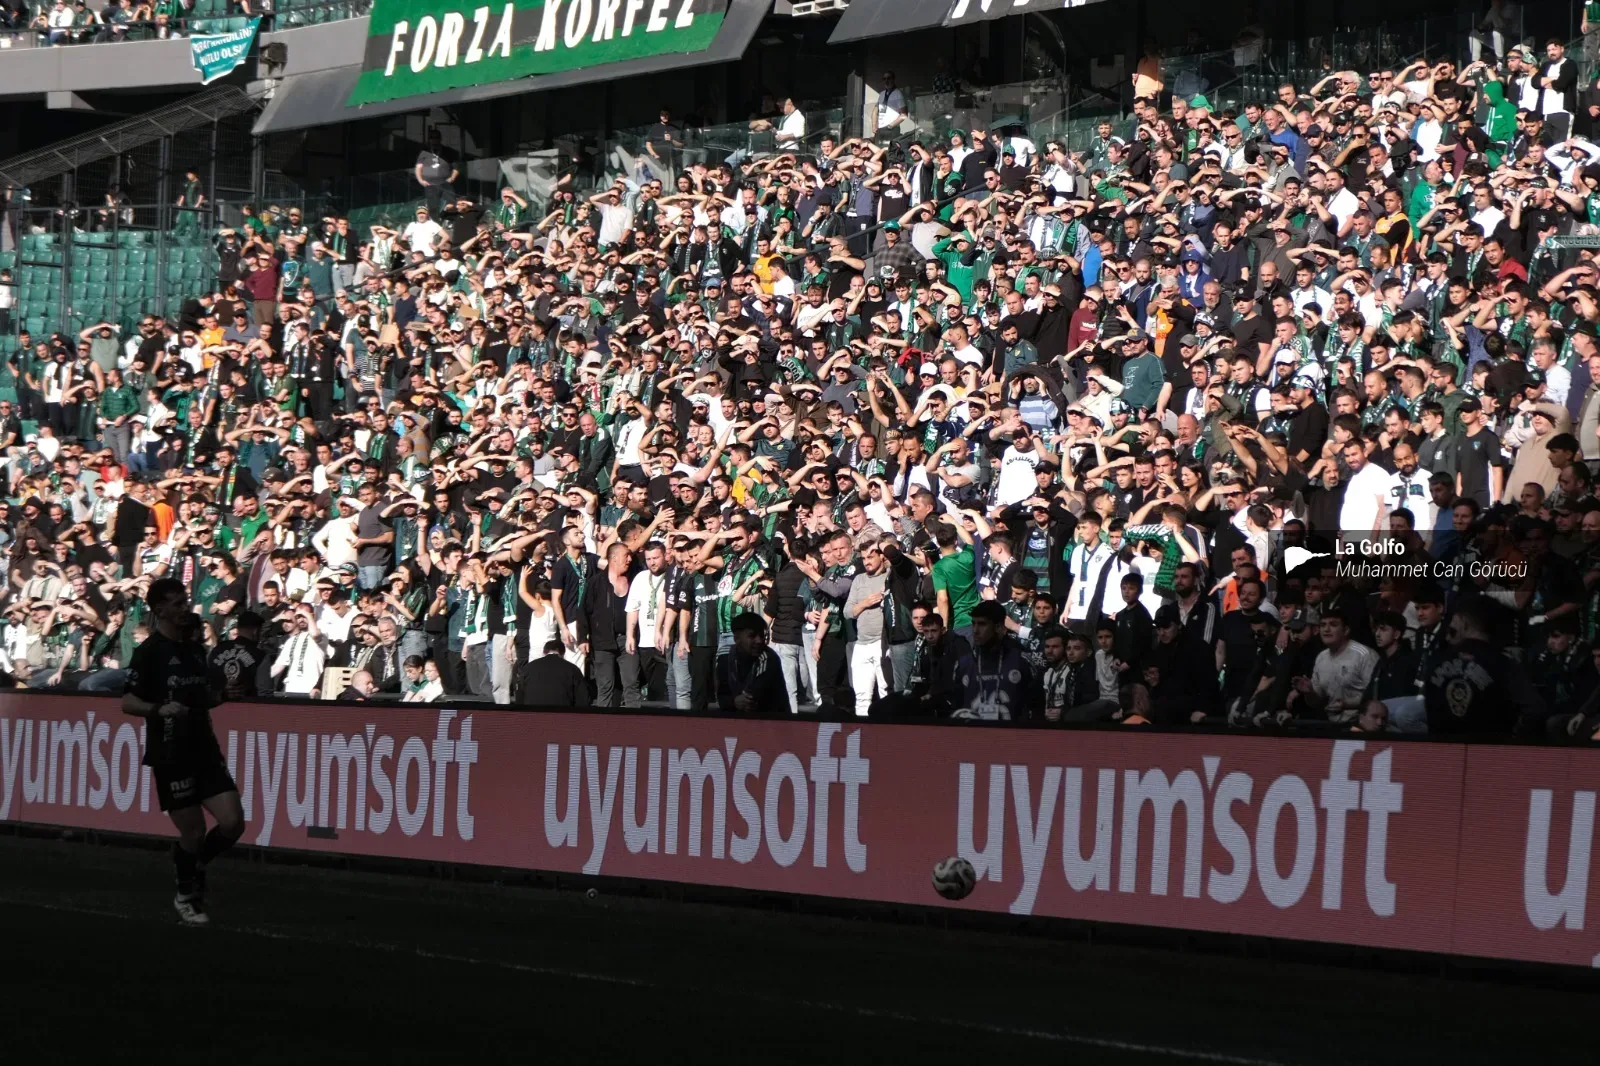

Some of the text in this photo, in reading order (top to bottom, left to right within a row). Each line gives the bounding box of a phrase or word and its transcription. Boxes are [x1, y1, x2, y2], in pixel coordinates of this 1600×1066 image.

[384, 3, 514, 77] FORZA
[227, 709, 478, 847] uyum'soft
[543, 722, 870, 875] uyum'soft
[957, 740, 1404, 915] uyum'soft
